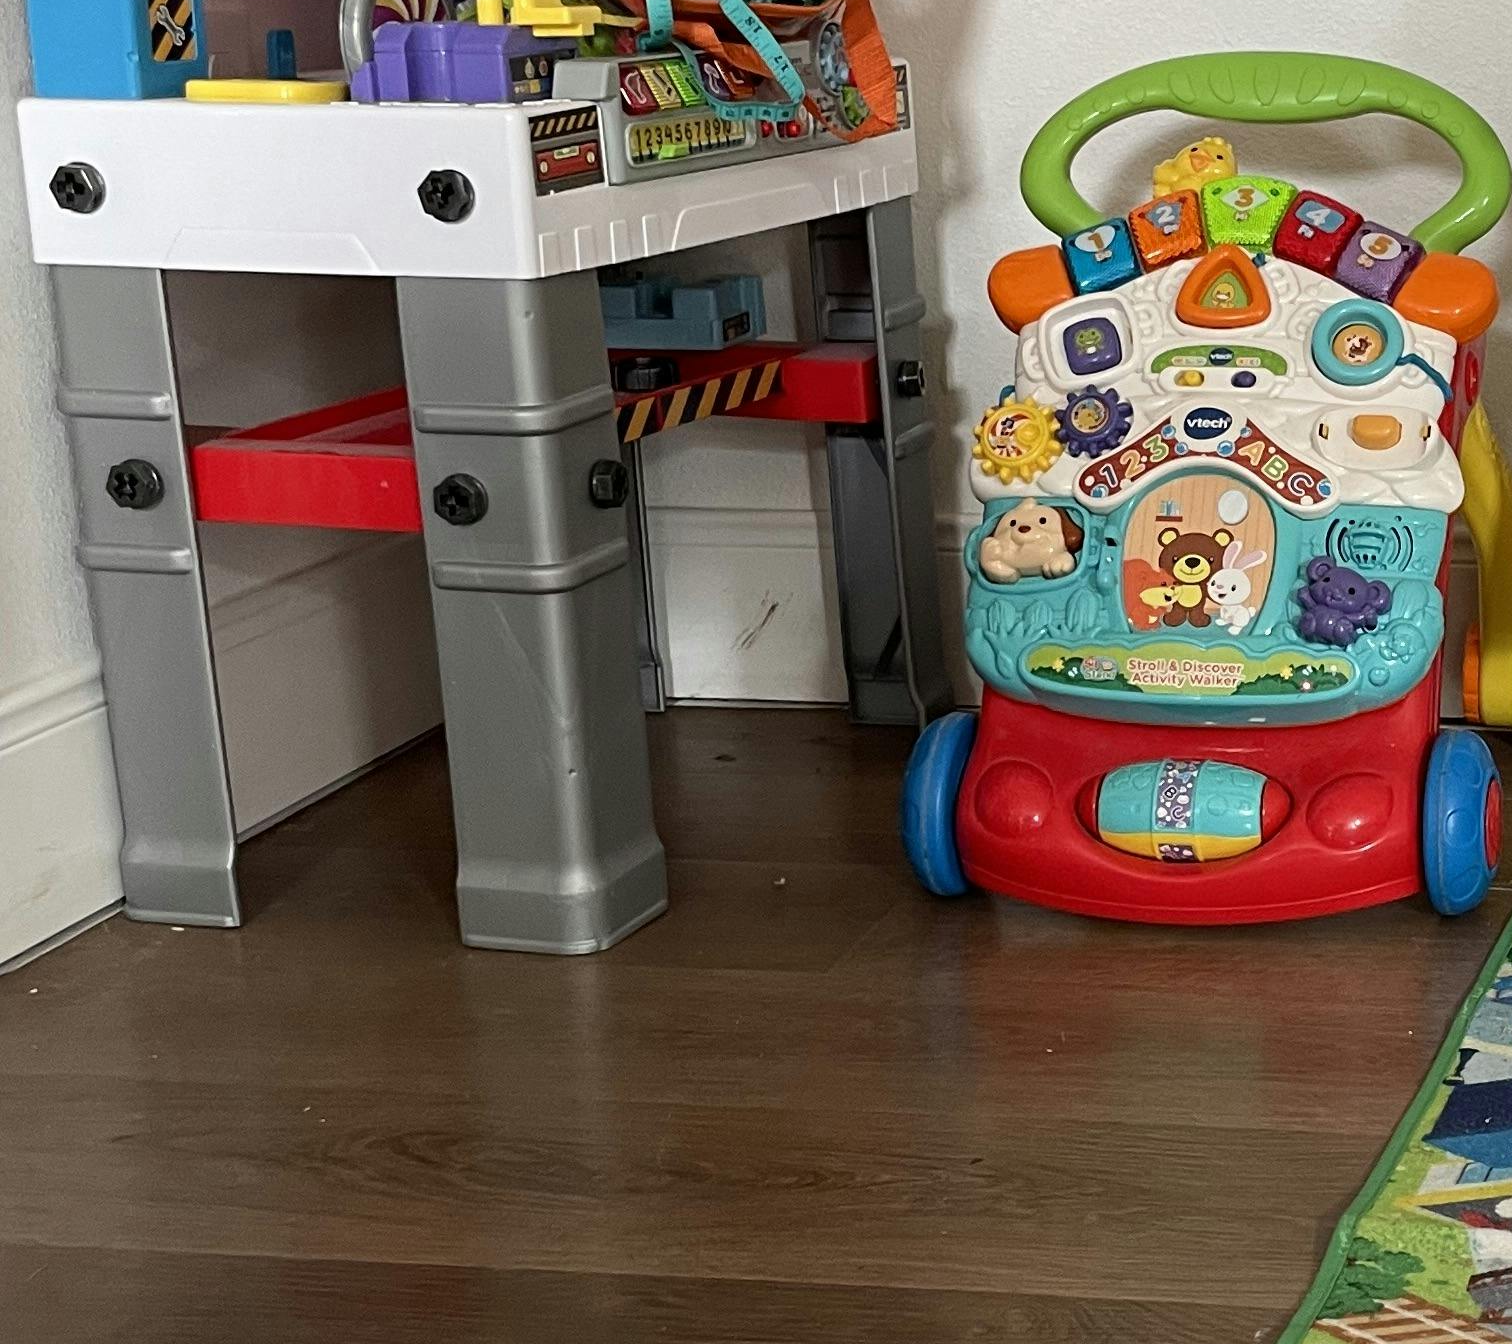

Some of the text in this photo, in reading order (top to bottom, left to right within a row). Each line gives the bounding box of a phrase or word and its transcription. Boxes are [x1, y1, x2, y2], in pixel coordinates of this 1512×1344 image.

[1234, 187, 1255, 208] 3
[1155, 205, 1176, 225] 2
[1306, 208, 1332, 228] 4
[1368, 234, 1393, 256] 5
[1186, 418, 1228, 429] vtech
[1128, 659, 1243, 674] Stroll & Discover
[1132, 672, 1239, 687] Activity Walker
